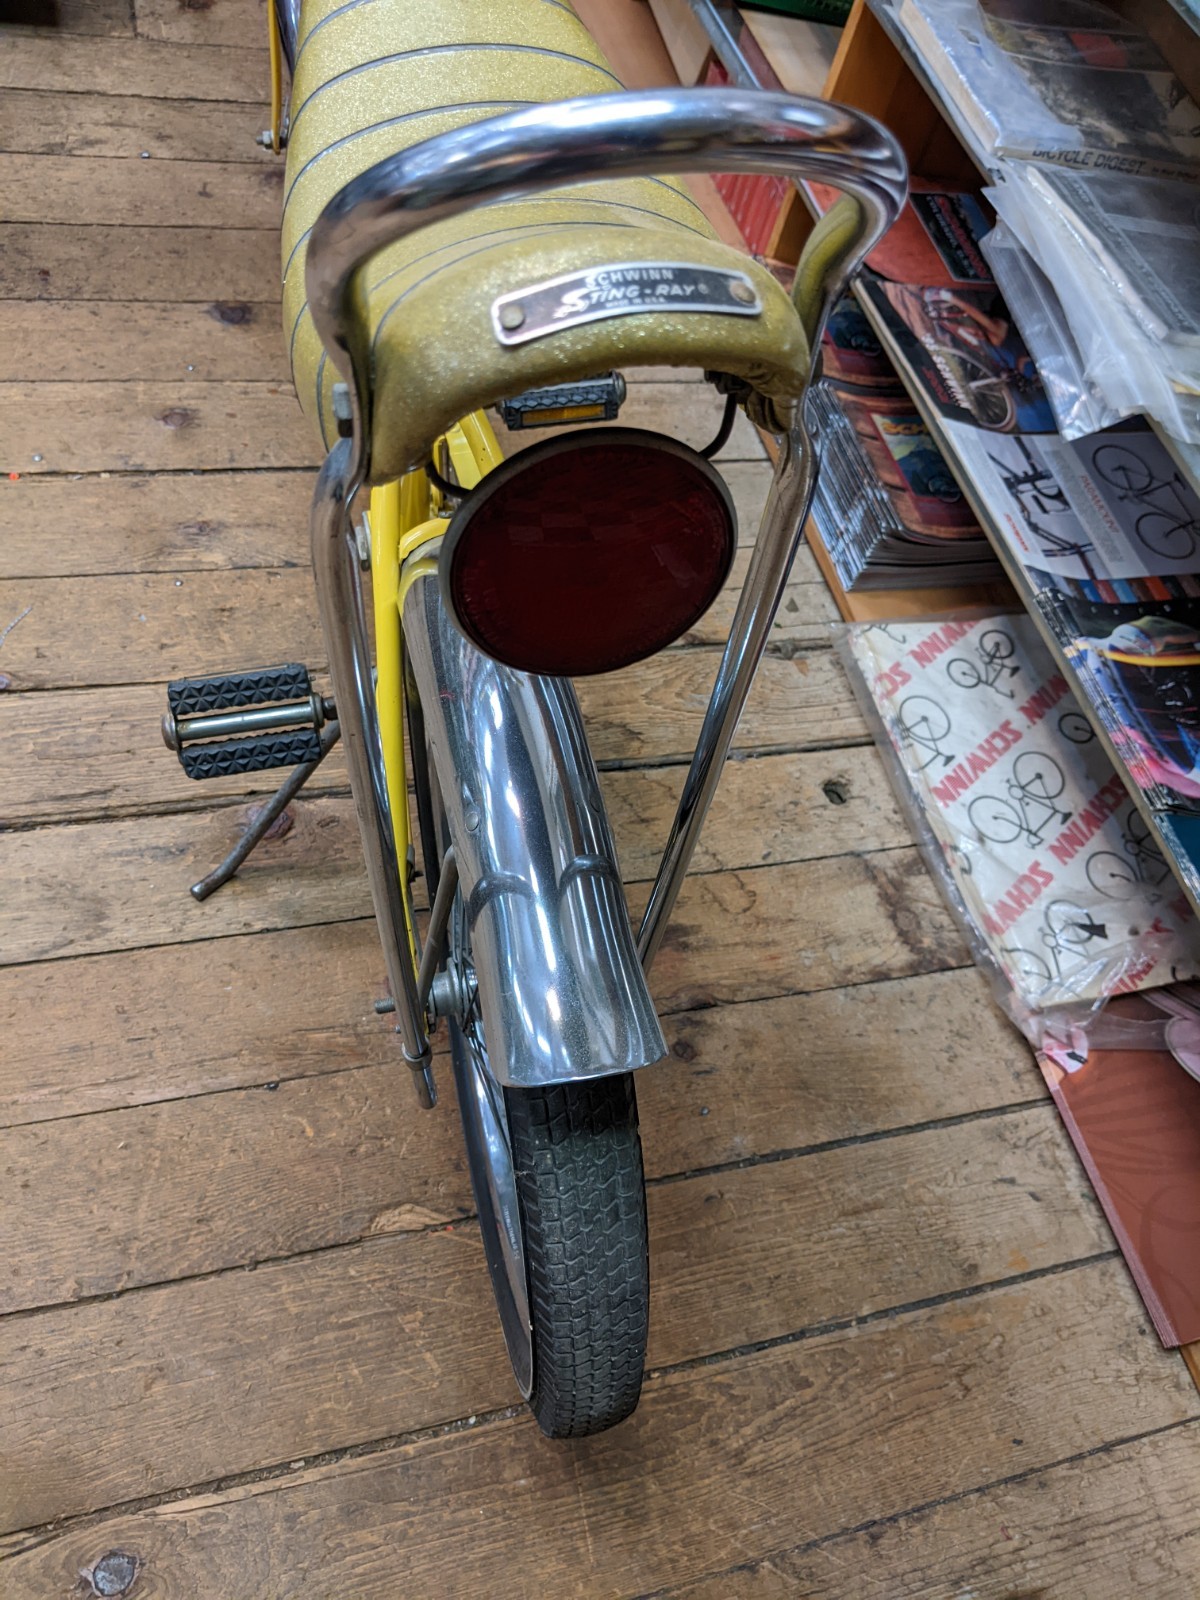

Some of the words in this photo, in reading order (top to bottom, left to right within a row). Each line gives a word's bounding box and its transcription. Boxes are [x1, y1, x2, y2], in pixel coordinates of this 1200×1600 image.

[1032, 147, 1093, 166] BICYCLE
[1093, 153, 1147, 175] DIGEST
[584, 268, 674, 291] SCHWINN
[930, 719, 1023, 809] SCHWINN
[1046, 773, 1129, 866] SCHWINN
